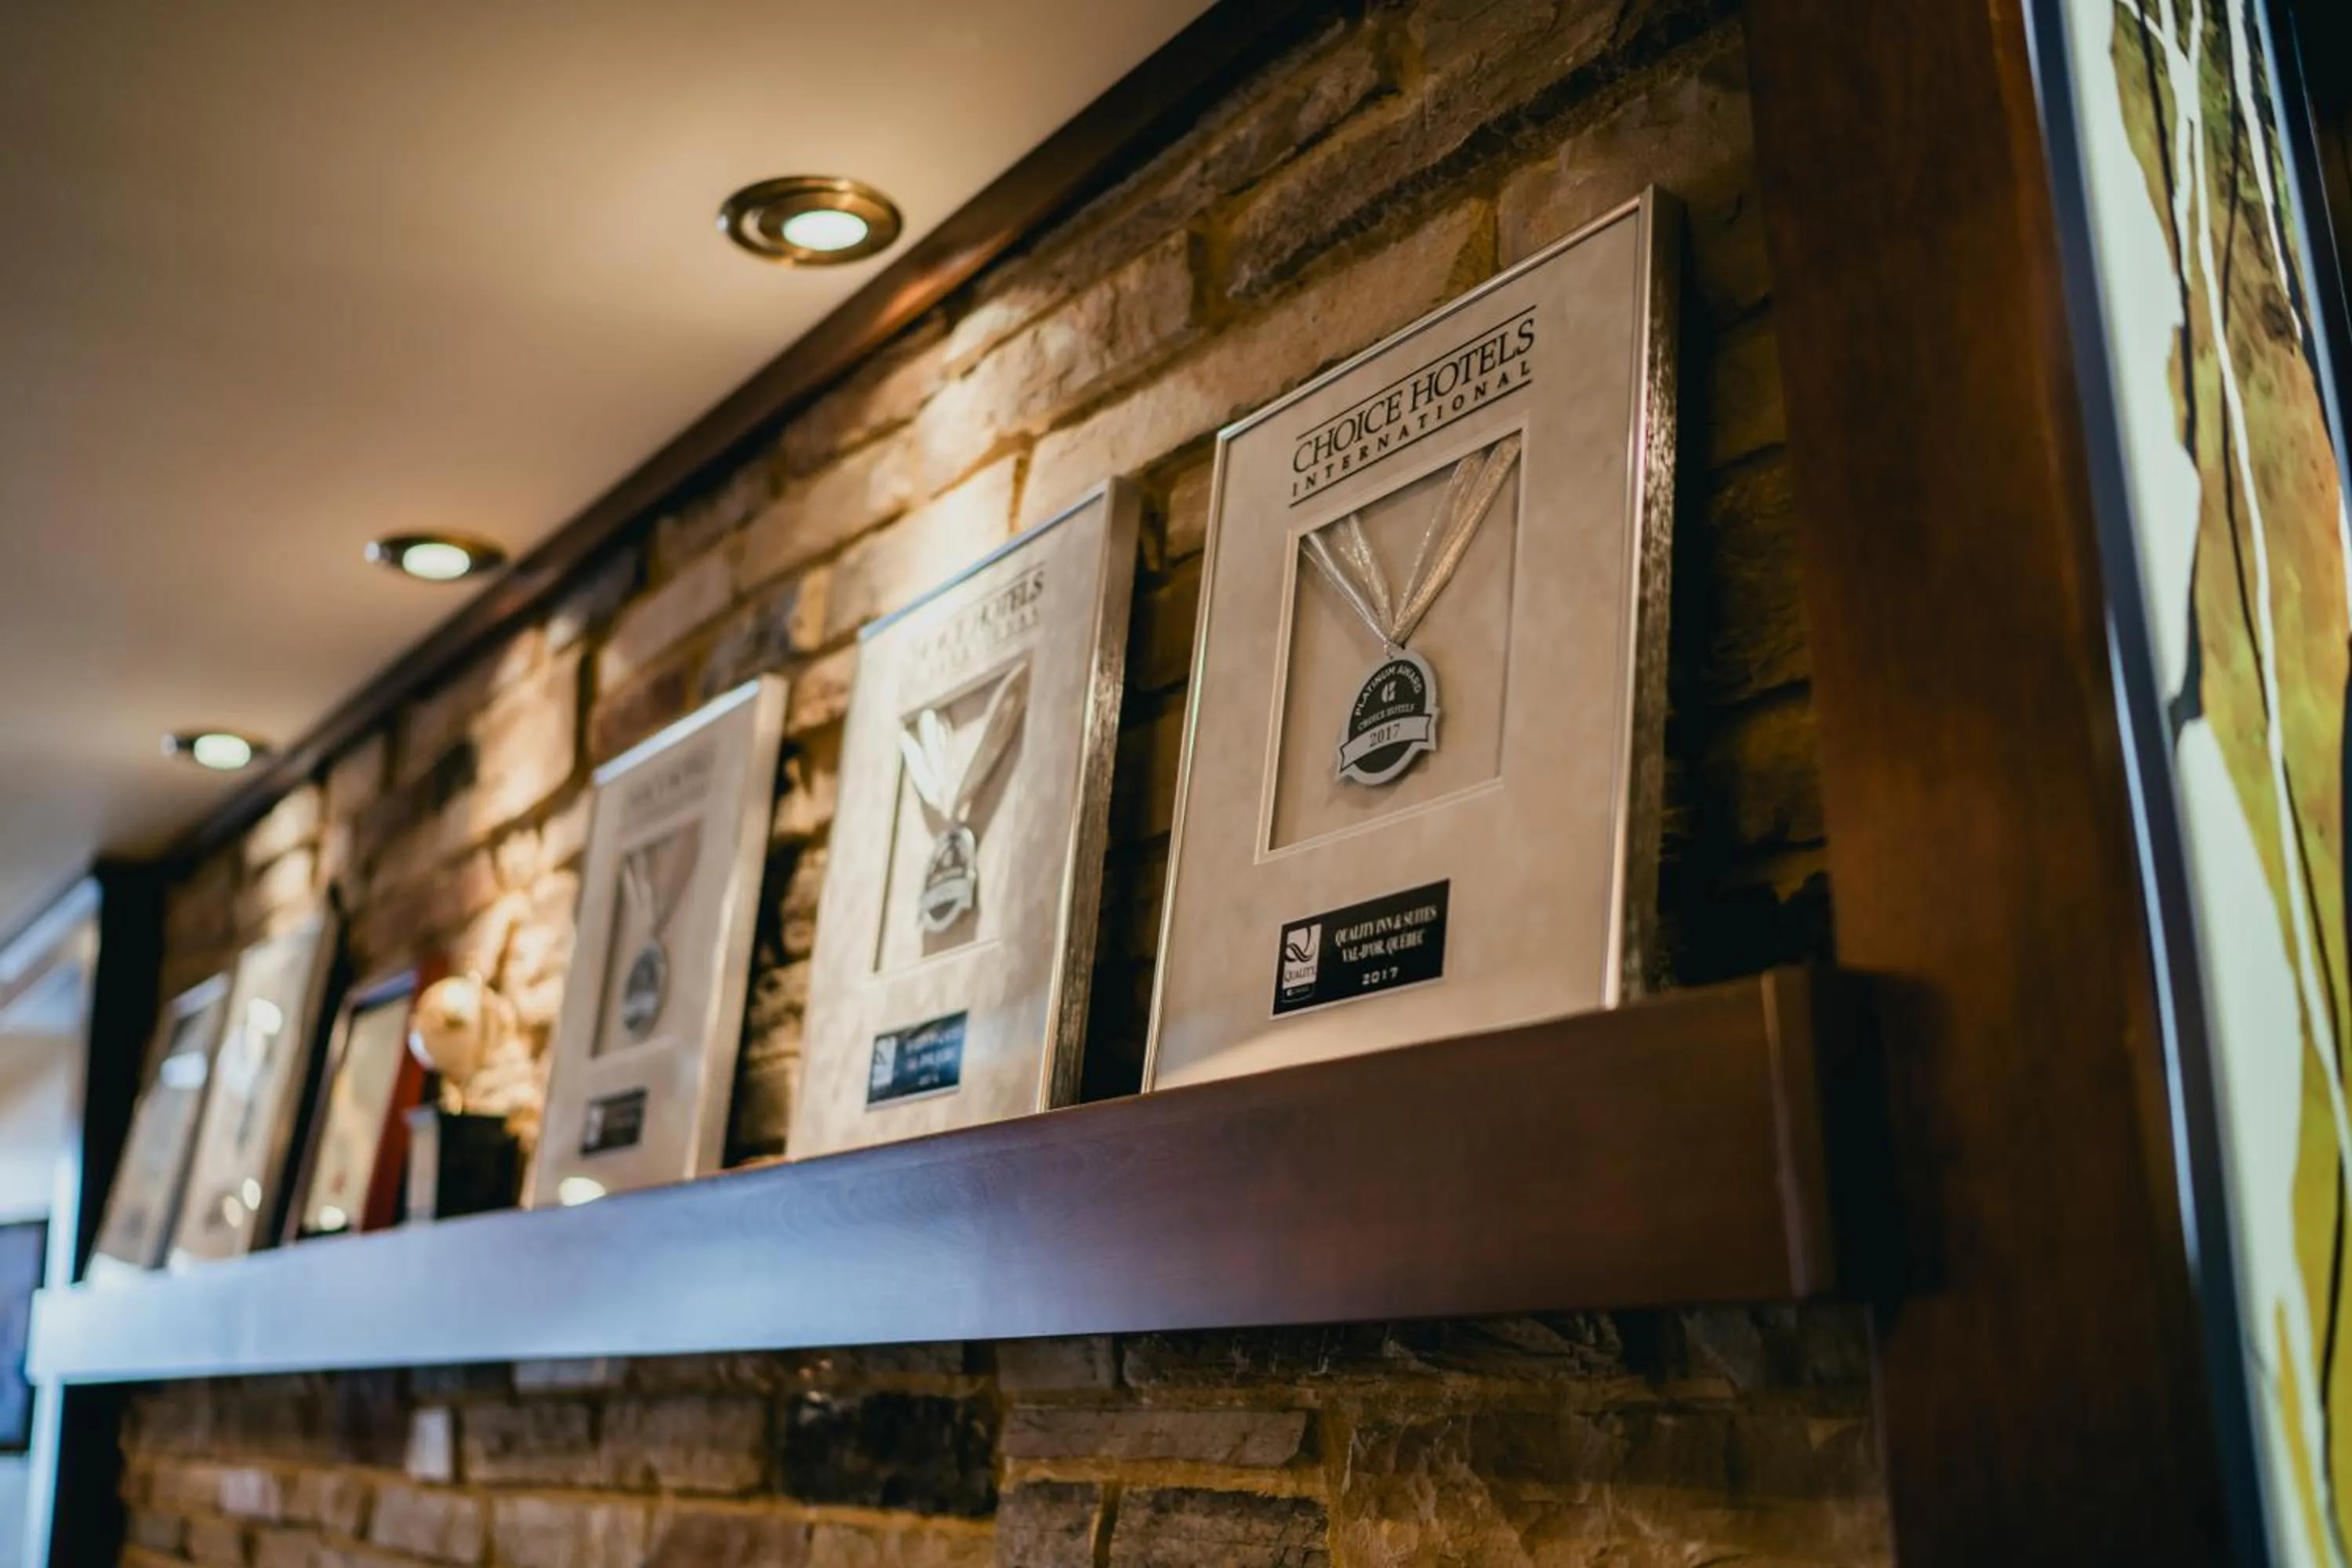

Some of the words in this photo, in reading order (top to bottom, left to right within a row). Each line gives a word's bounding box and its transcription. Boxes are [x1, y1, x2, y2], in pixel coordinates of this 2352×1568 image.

[1293, 391, 1403, 473] CHOICE
[1408, 318, 1534, 413] HOTELS
[1291, 361, 1531, 497] INTERNATIONAL
[1355, 666, 1396, 717] PLATINUM
[1370, 723, 1400, 746] 2017
[1334, 922, 1374, 947] QUALITY
[1403, 905, 1437, 925] SUITES
[1362, 967, 1399, 985] 2017
